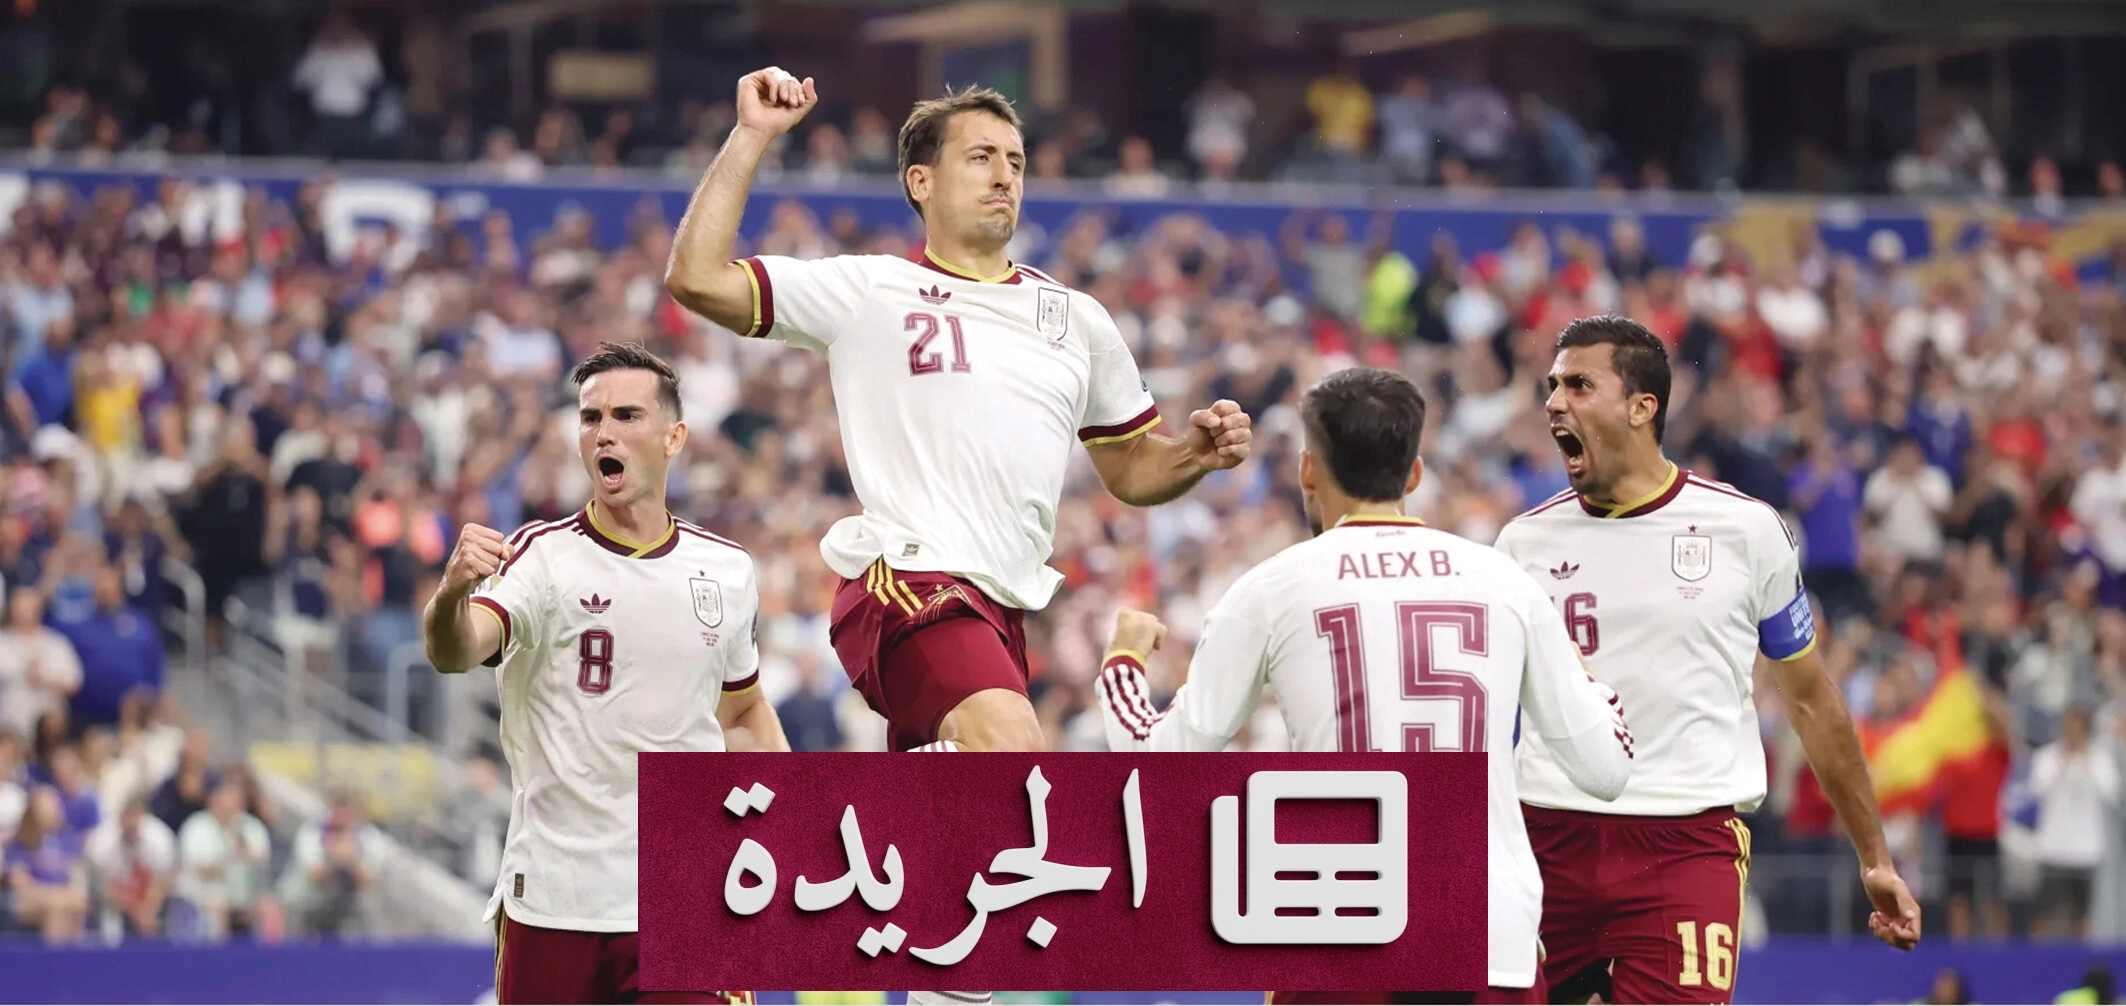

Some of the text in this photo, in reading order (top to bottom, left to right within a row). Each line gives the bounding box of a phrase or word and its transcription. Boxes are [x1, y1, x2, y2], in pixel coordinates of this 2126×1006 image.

[903, 312, 971, 377] 21
[1337, 550, 1461, 580] ALEX B.
[1550, 592, 1600, 656] 6
[577, 628, 615, 694] 8
[1313, 601, 1488, 752] 15
[1677, 921, 1733, 991] 16
